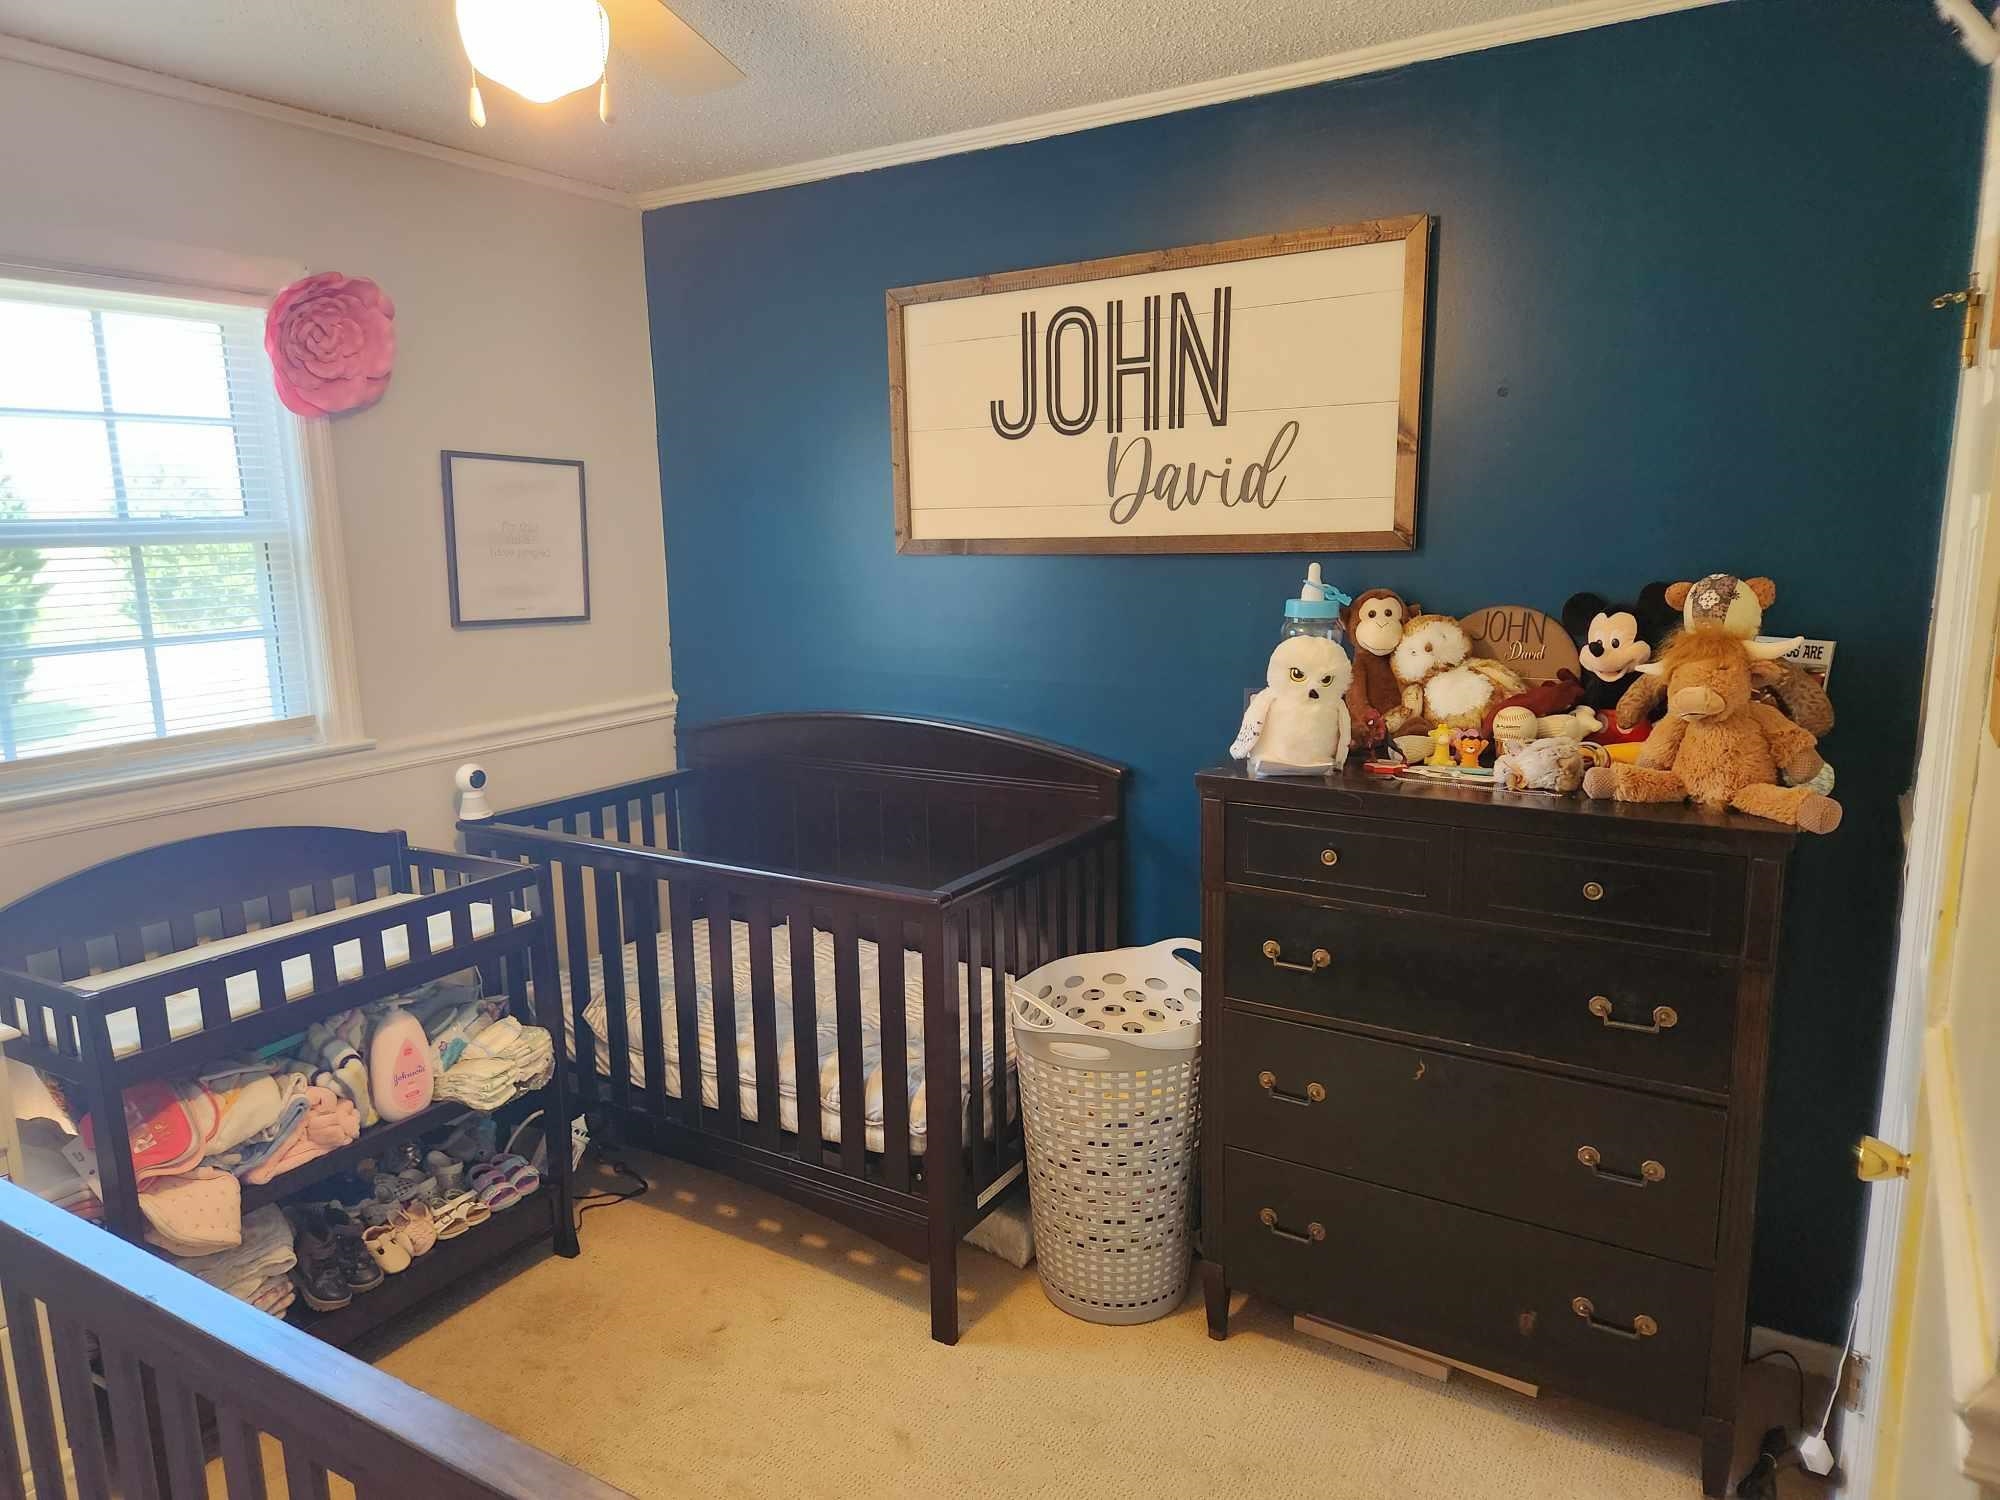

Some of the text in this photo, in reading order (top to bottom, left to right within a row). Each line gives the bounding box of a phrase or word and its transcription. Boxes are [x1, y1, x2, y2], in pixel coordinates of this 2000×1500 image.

[990, 286, 1232, 440] JOHN
[1106, 420, 1300, 525] David
[1471, 610, 1546, 644] JOHN
[1506, 639, 1546, 661] David
[1802, 644, 1824, 660] ARE
